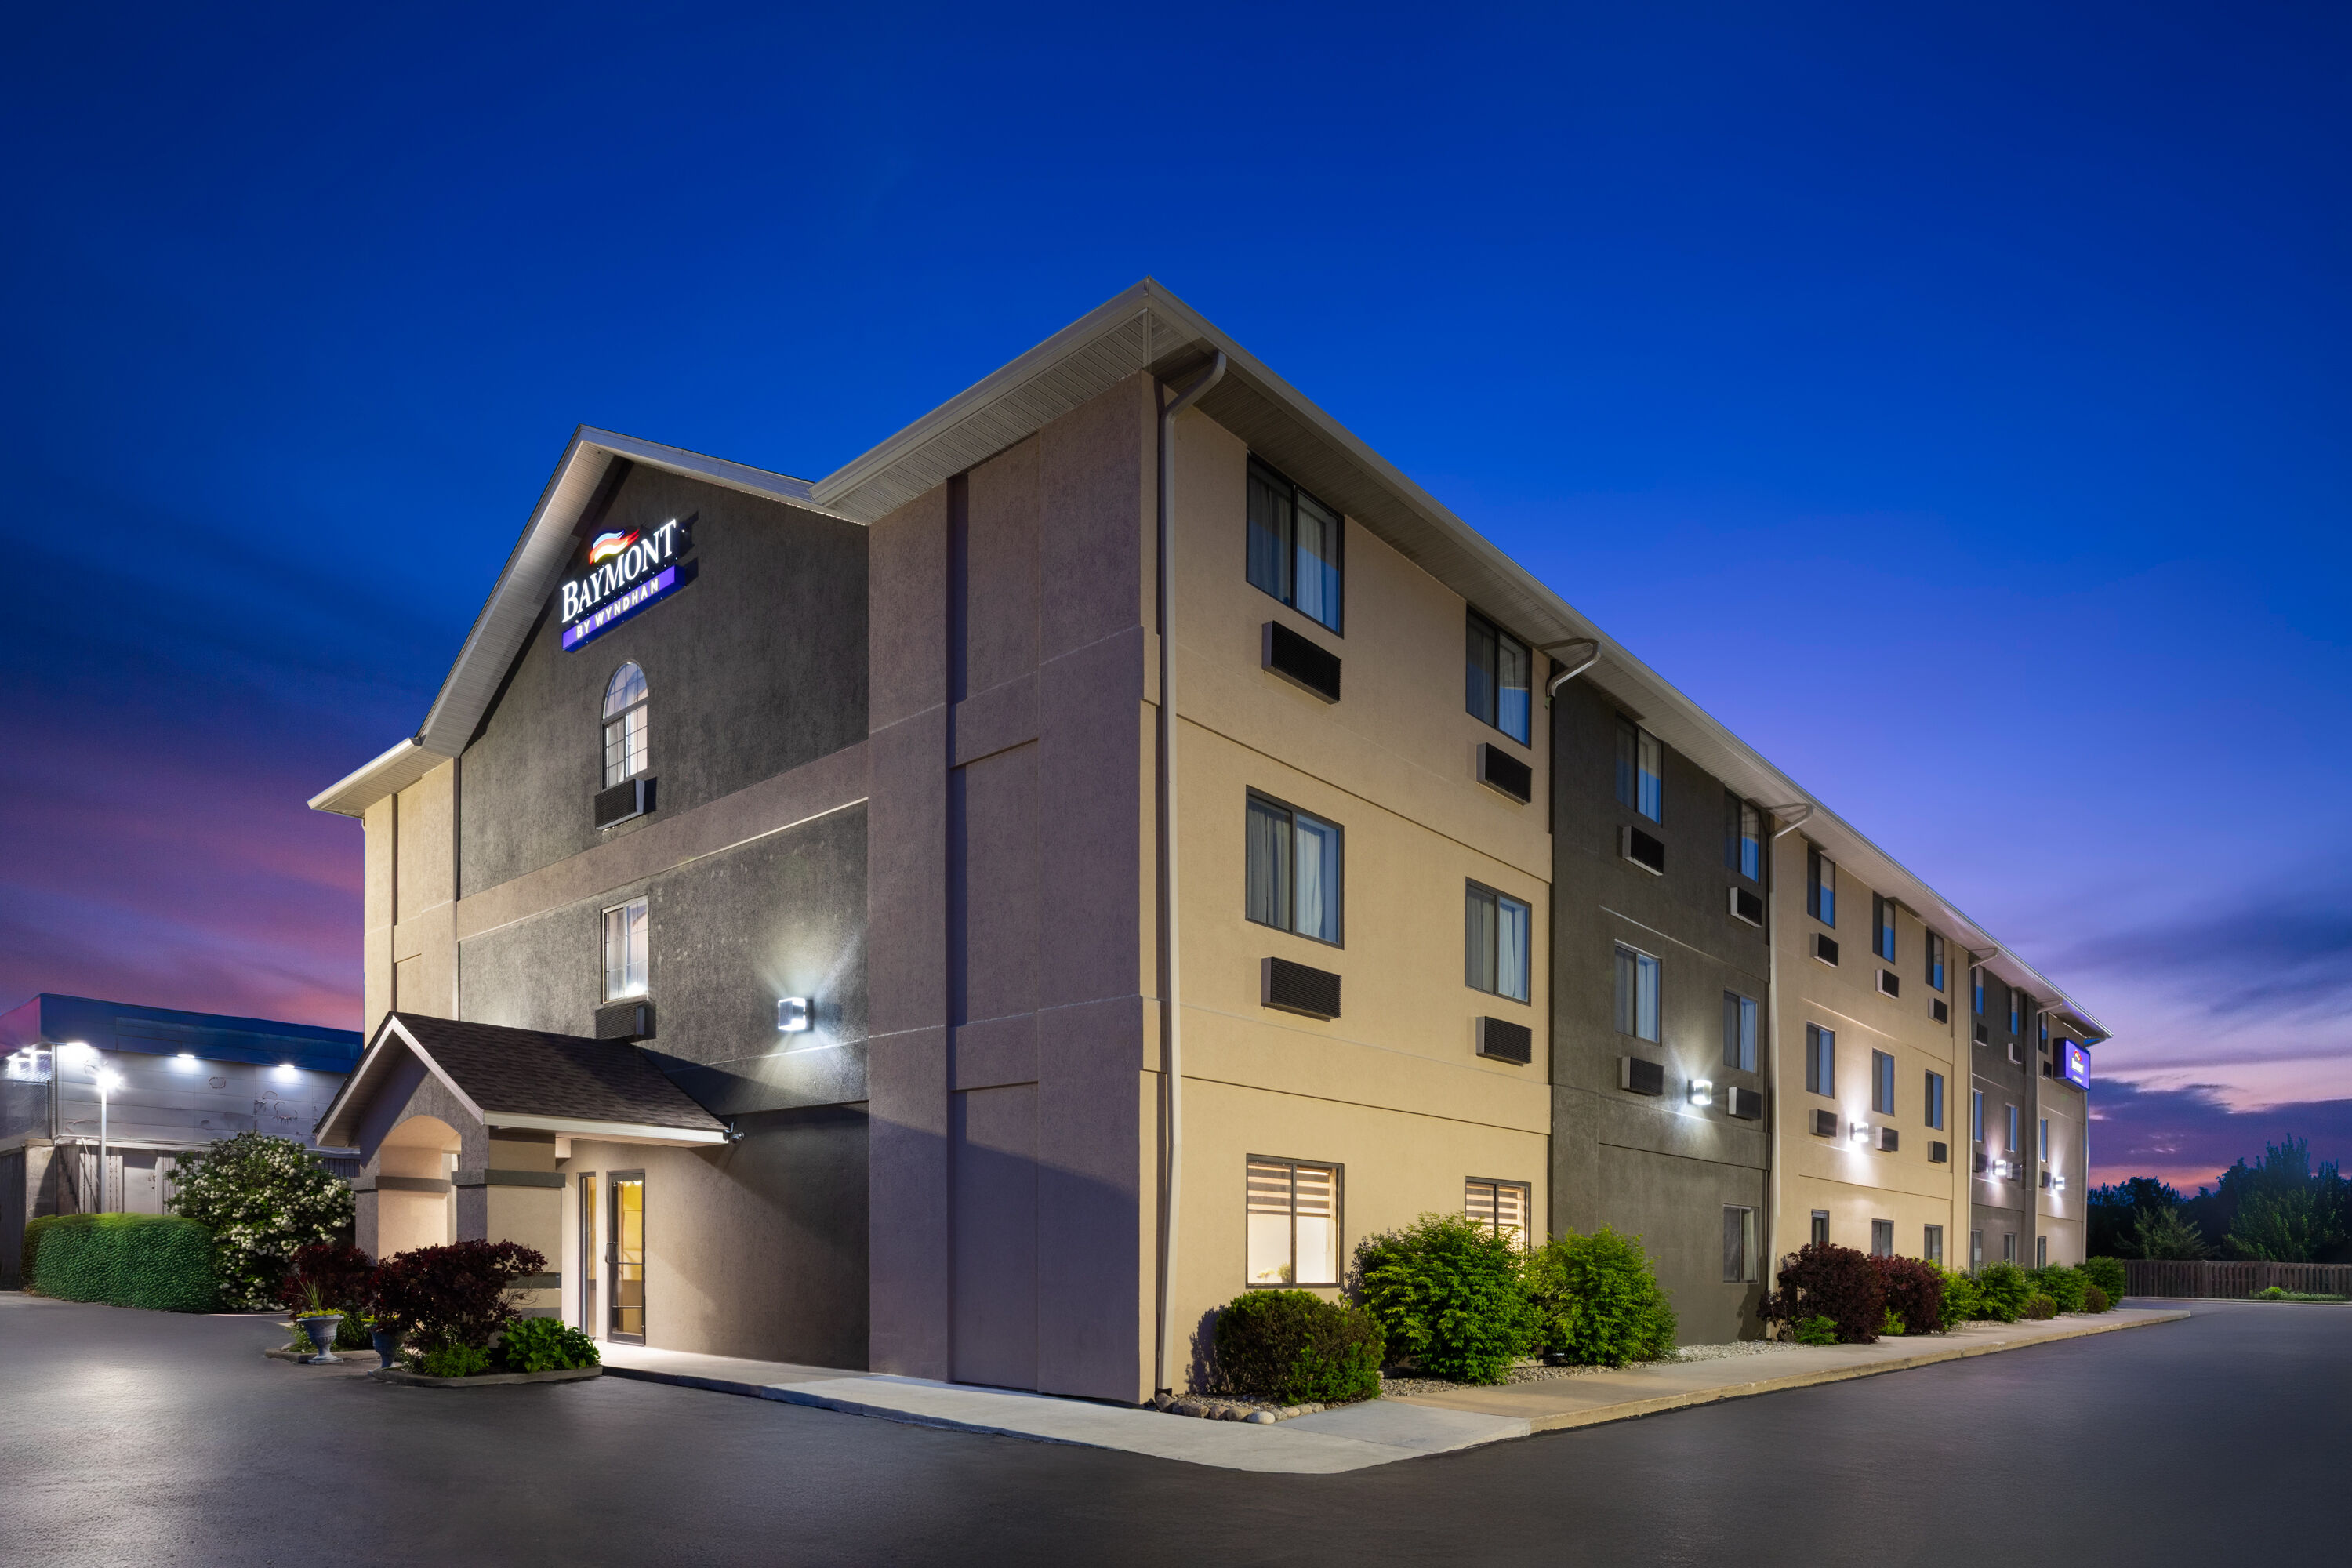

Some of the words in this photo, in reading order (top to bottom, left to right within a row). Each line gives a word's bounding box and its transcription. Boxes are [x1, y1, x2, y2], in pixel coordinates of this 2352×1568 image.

[561, 518, 677, 623] BAYMONT
[576, 619, 590, 639] BY
[594, 578, 659, 627] WYNDHAM
